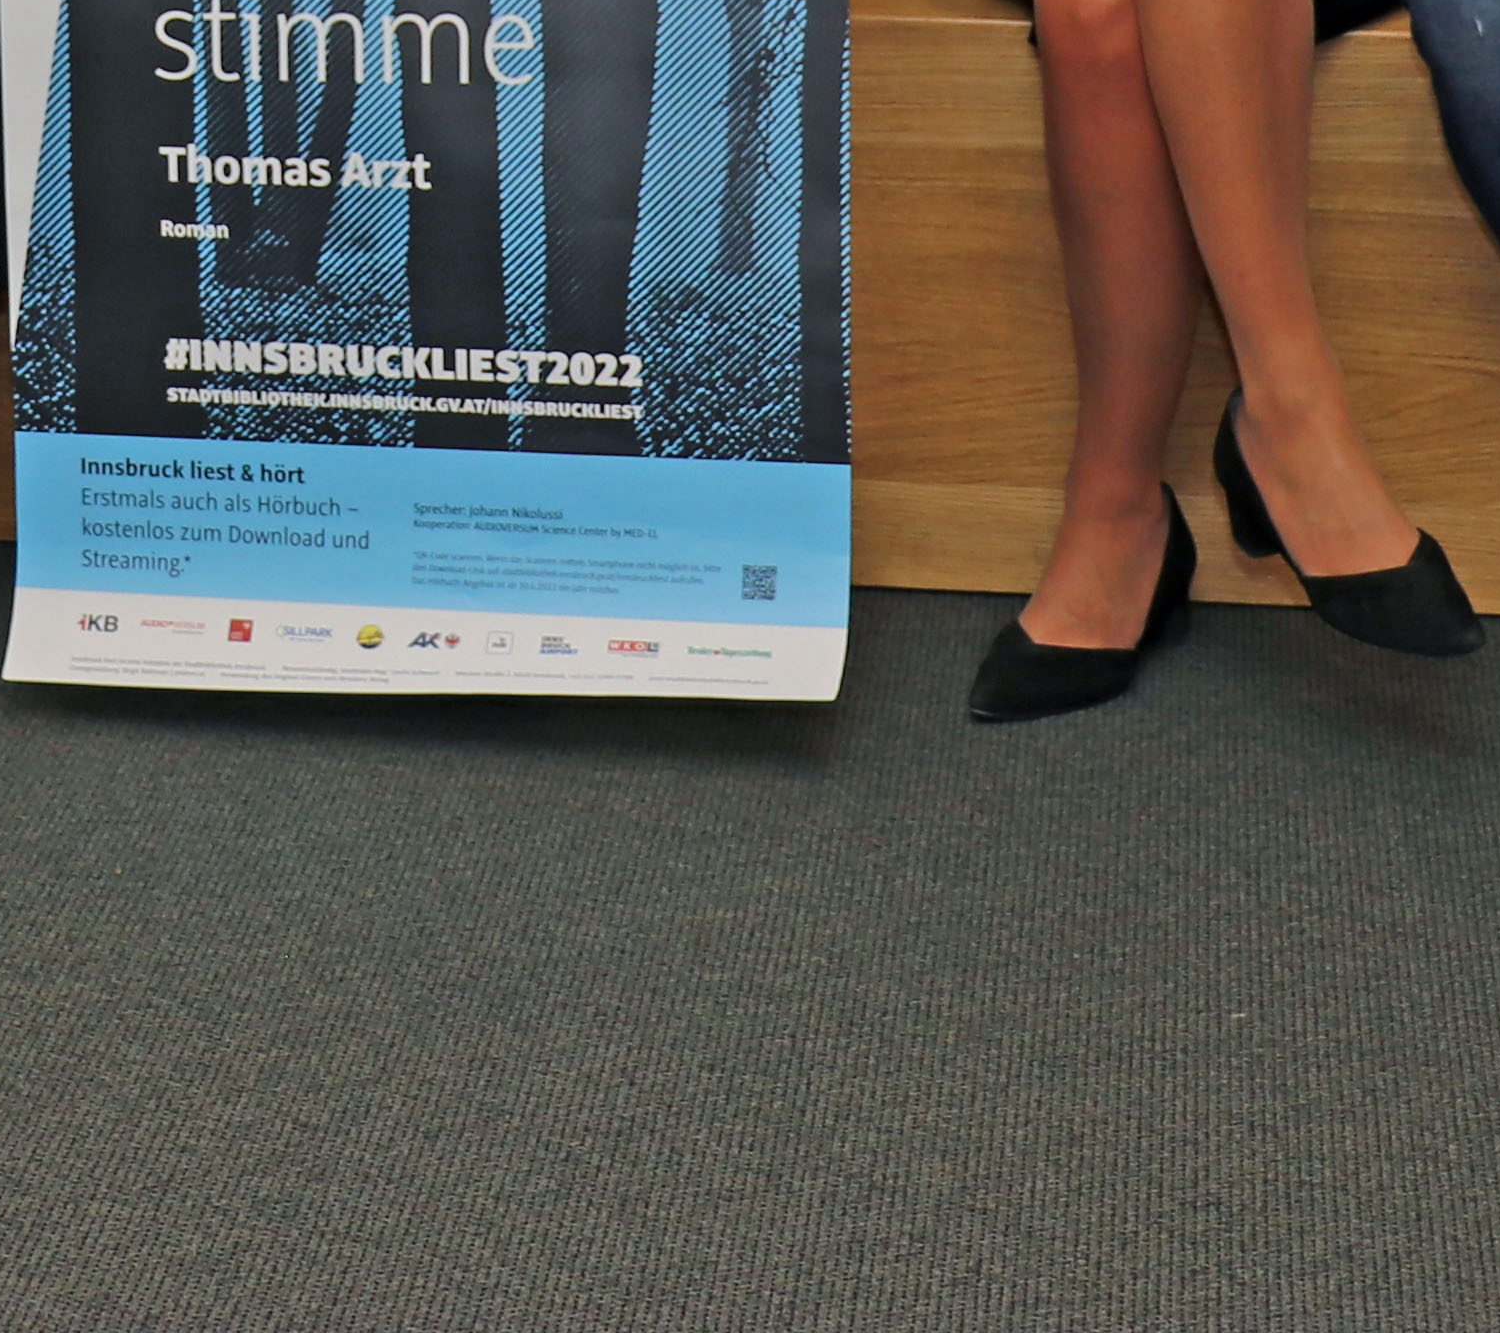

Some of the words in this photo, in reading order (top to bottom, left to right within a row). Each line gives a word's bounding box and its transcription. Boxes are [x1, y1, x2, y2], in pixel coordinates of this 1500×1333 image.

[159, 145, 330, 188] Thomas
[341, 150, 432, 190] Arzt
[160, 220, 230, 240] Roman
[164, 337, 644, 387] #INNSBRUCKLIEST2022
[166, 386, 643, 420] STADTBIBLIOTHEK.INNSBRUCK.GV.AT/INNSBRUCKLIEST
[81, 458, 184, 479] Innsbruck
[190, 461, 235, 481] liest
[241, 464, 254, 482] &
[260, 464, 305, 484] hört
[81, 489, 165, 510] Erstmals
[171, 491, 218, 512] auch
[224, 494, 252, 513] als
[258, 496, 341, 517] Hörbuch
[469, 506, 509, 518] Johann
[81, 519, 174, 541] kostenlos
[180, 528, 223, 543] zum
[229, 526, 325, 548] Download
[332, 531, 370, 550] und
